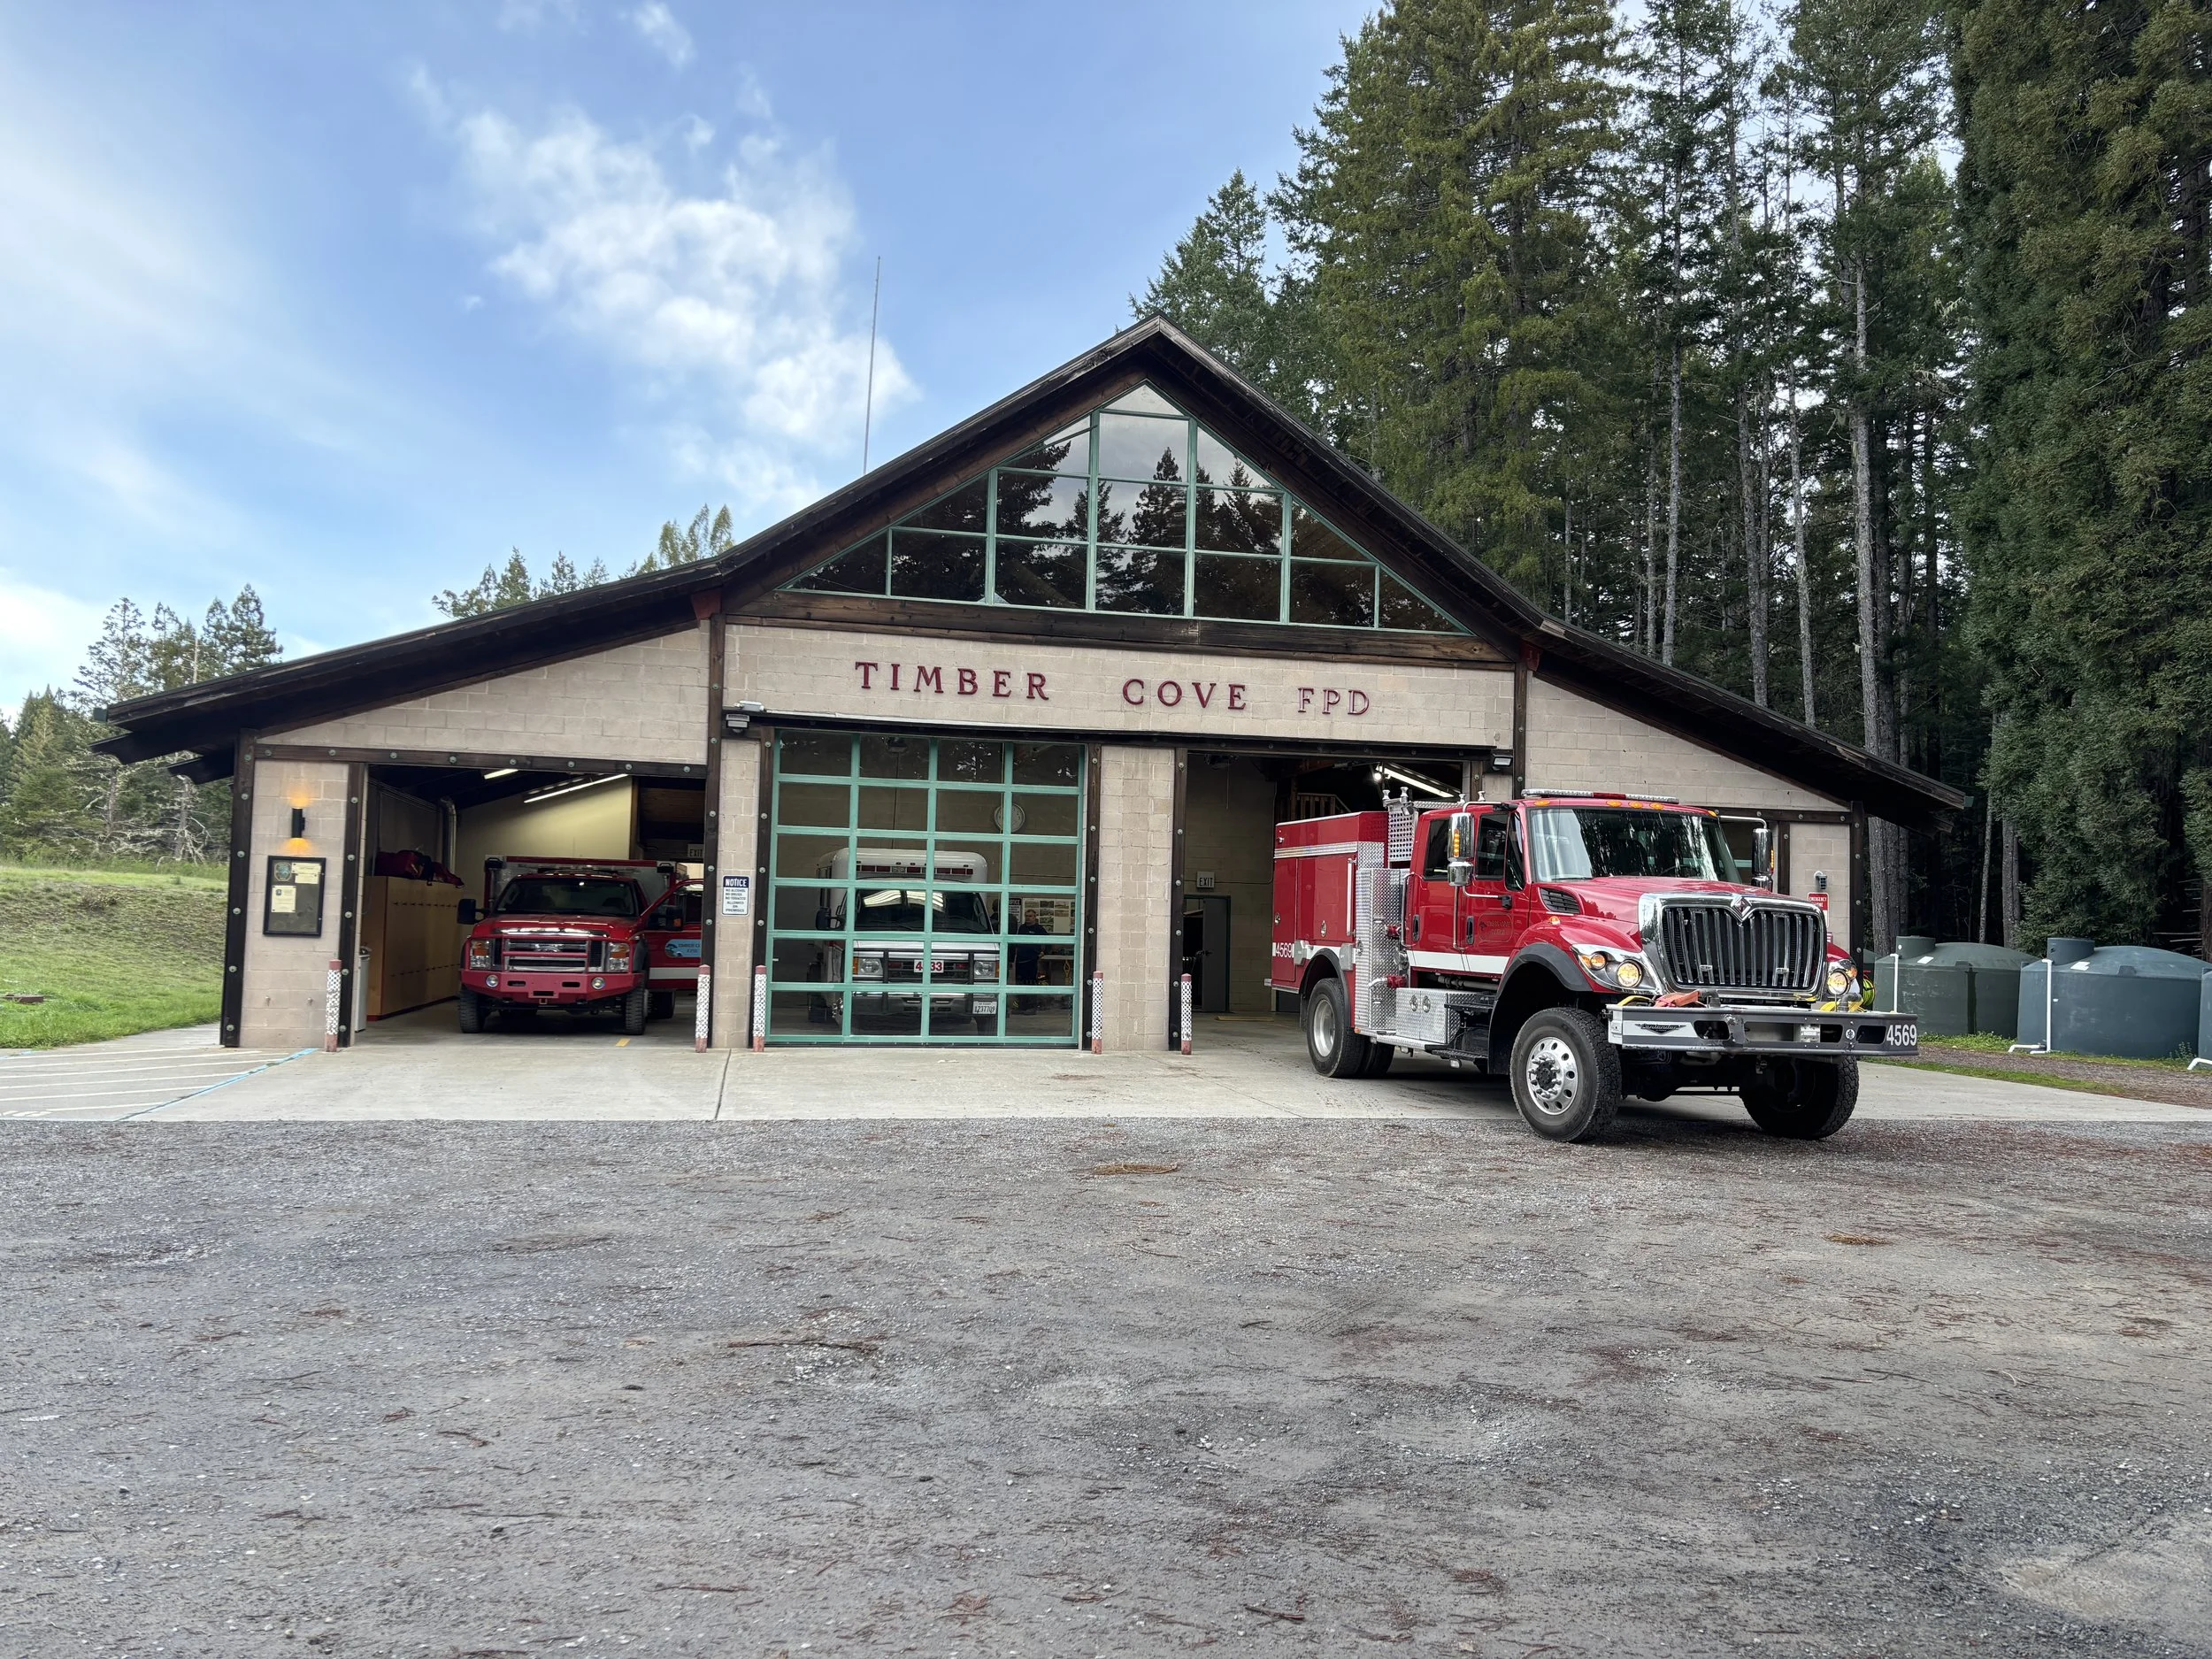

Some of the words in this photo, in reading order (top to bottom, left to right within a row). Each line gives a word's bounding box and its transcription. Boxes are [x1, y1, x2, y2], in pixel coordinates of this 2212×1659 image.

[856, 662, 1049, 701] TIMBER
[1123, 679, 1246, 710] COVE
[1298, 687, 1370, 715] FPD
[726, 878, 747, 887] NOTICE
[1199, 877, 1213, 886] EXIT
[1276, 942, 1292, 958] 4569
[915, 961, 943, 972] 433
[1886, 1024, 1917, 1046] 4569
